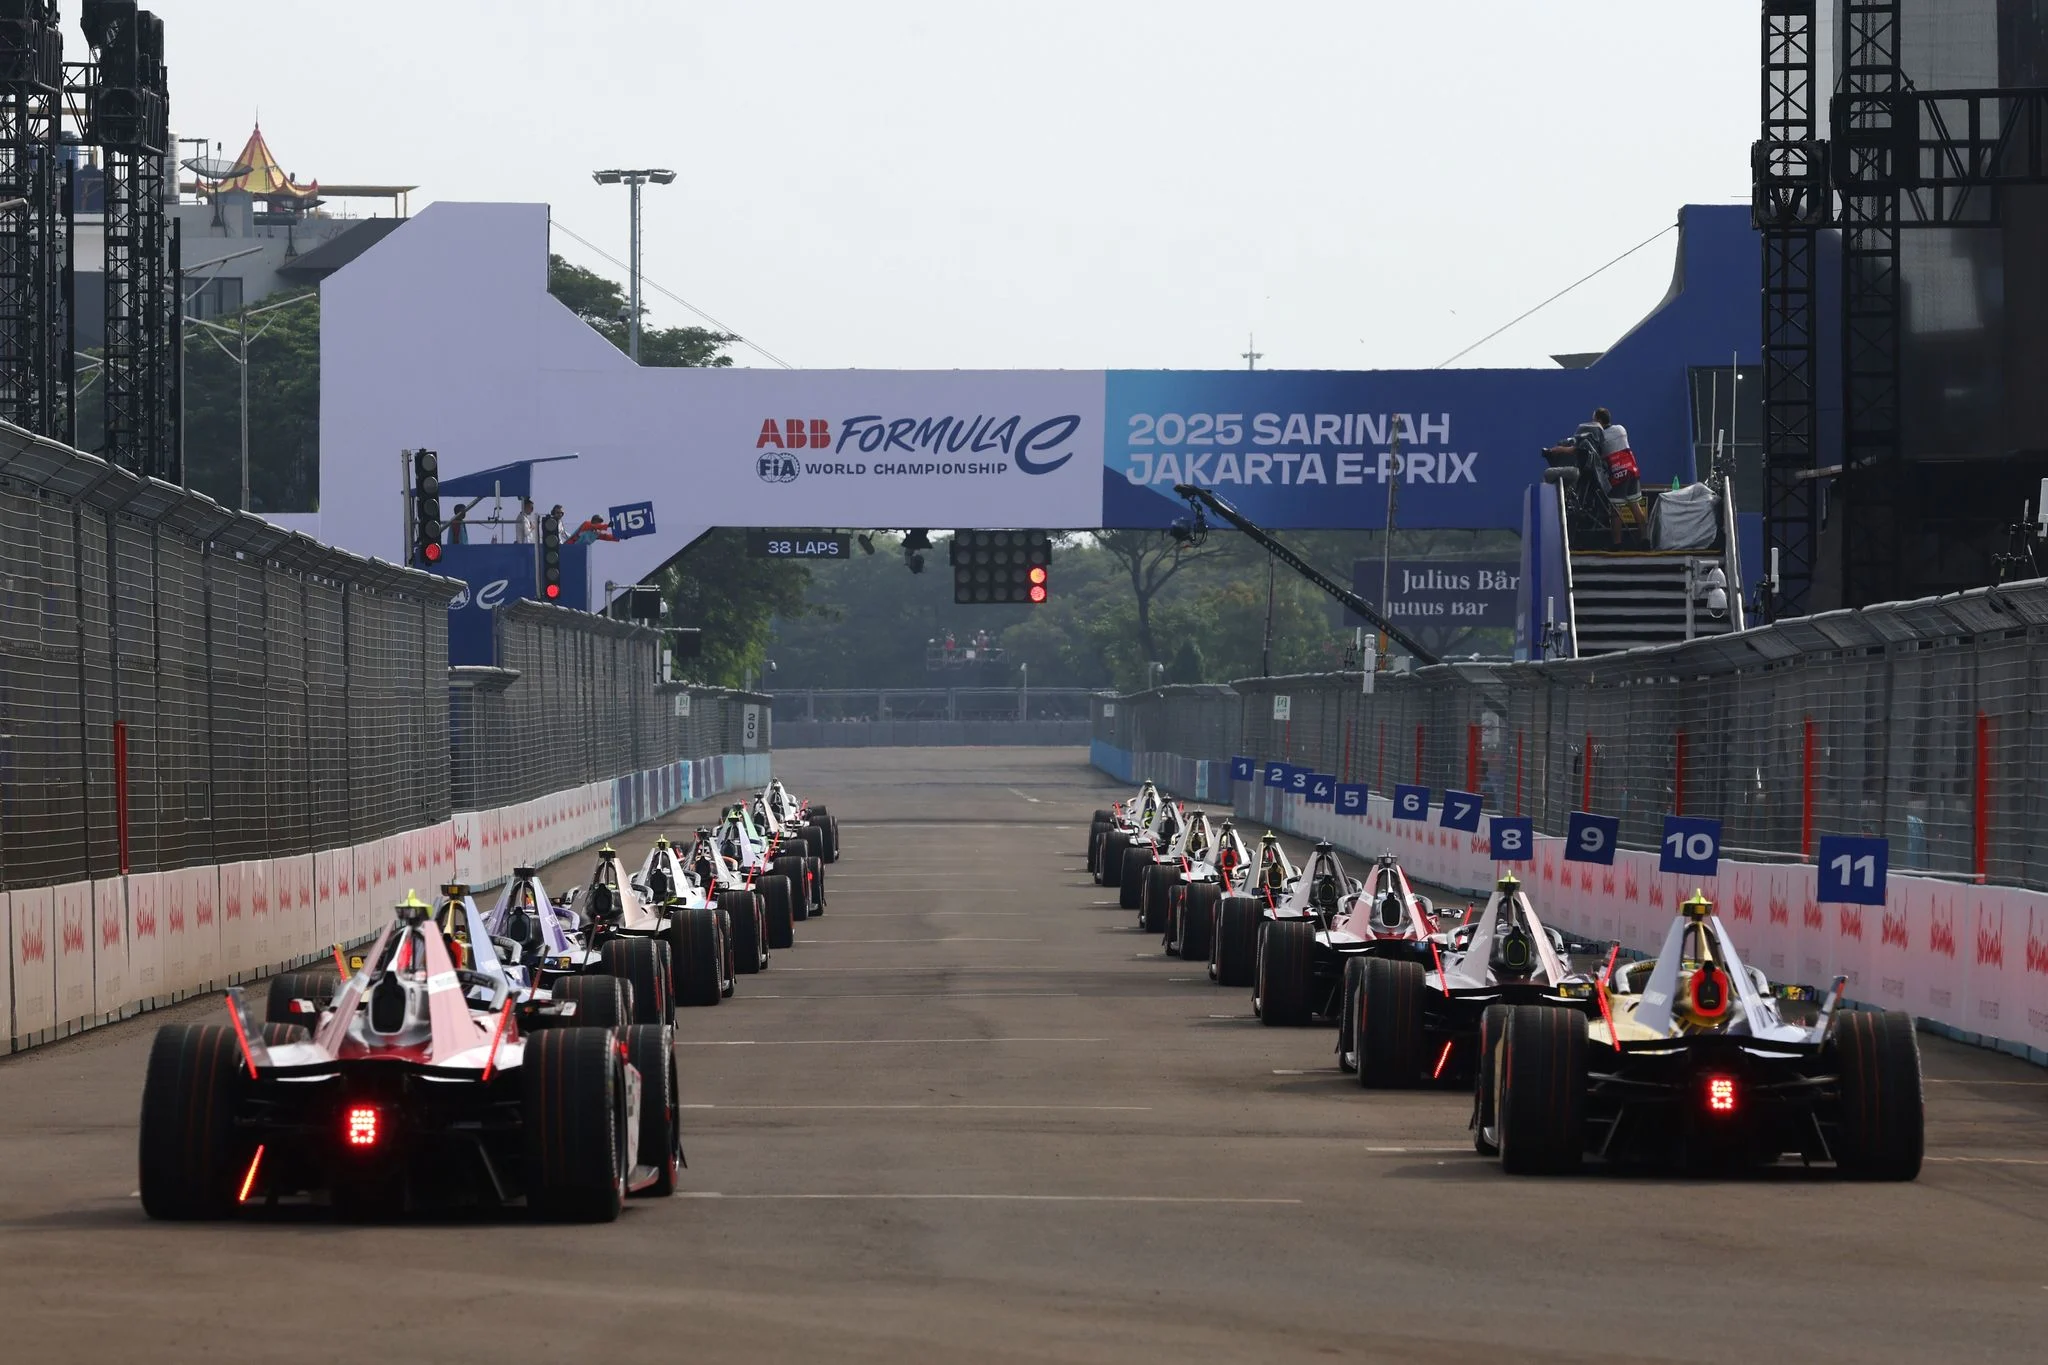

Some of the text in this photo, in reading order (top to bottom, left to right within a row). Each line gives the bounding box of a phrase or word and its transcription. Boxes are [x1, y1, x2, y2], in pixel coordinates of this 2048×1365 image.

[756, 418, 832, 449] ABB
[835, 415, 1020, 454] FORMULA
[1128, 412, 1451, 445] 2025 SARINAH
[805, 463, 866, 475] WORLD
[874, 462, 1009, 475] CHAMPIONSHIP
[1126, 451, 1478, 485] JAKARTA E-PRIX
[767, 541, 840, 555] 38 LAPS
[1402, 569, 1520, 594] Julius Bär
[1238, 763, 1248, 775] 1
[1271, 769, 1282, 781] 2
[1294, 774, 1306, 787] 3
[1314, 782, 1329, 797] 4
[1344, 791, 1360, 807] 5
[1403, 794, 1420, 810] 6
[1453, 802, 1474, 820] 7
[1501, 828, 1522, 850] 8
[1580, 827, 1605, 852] 9
[1665, 831, 1715, 861] 10
[1830, 855, 1876, 889] 11
